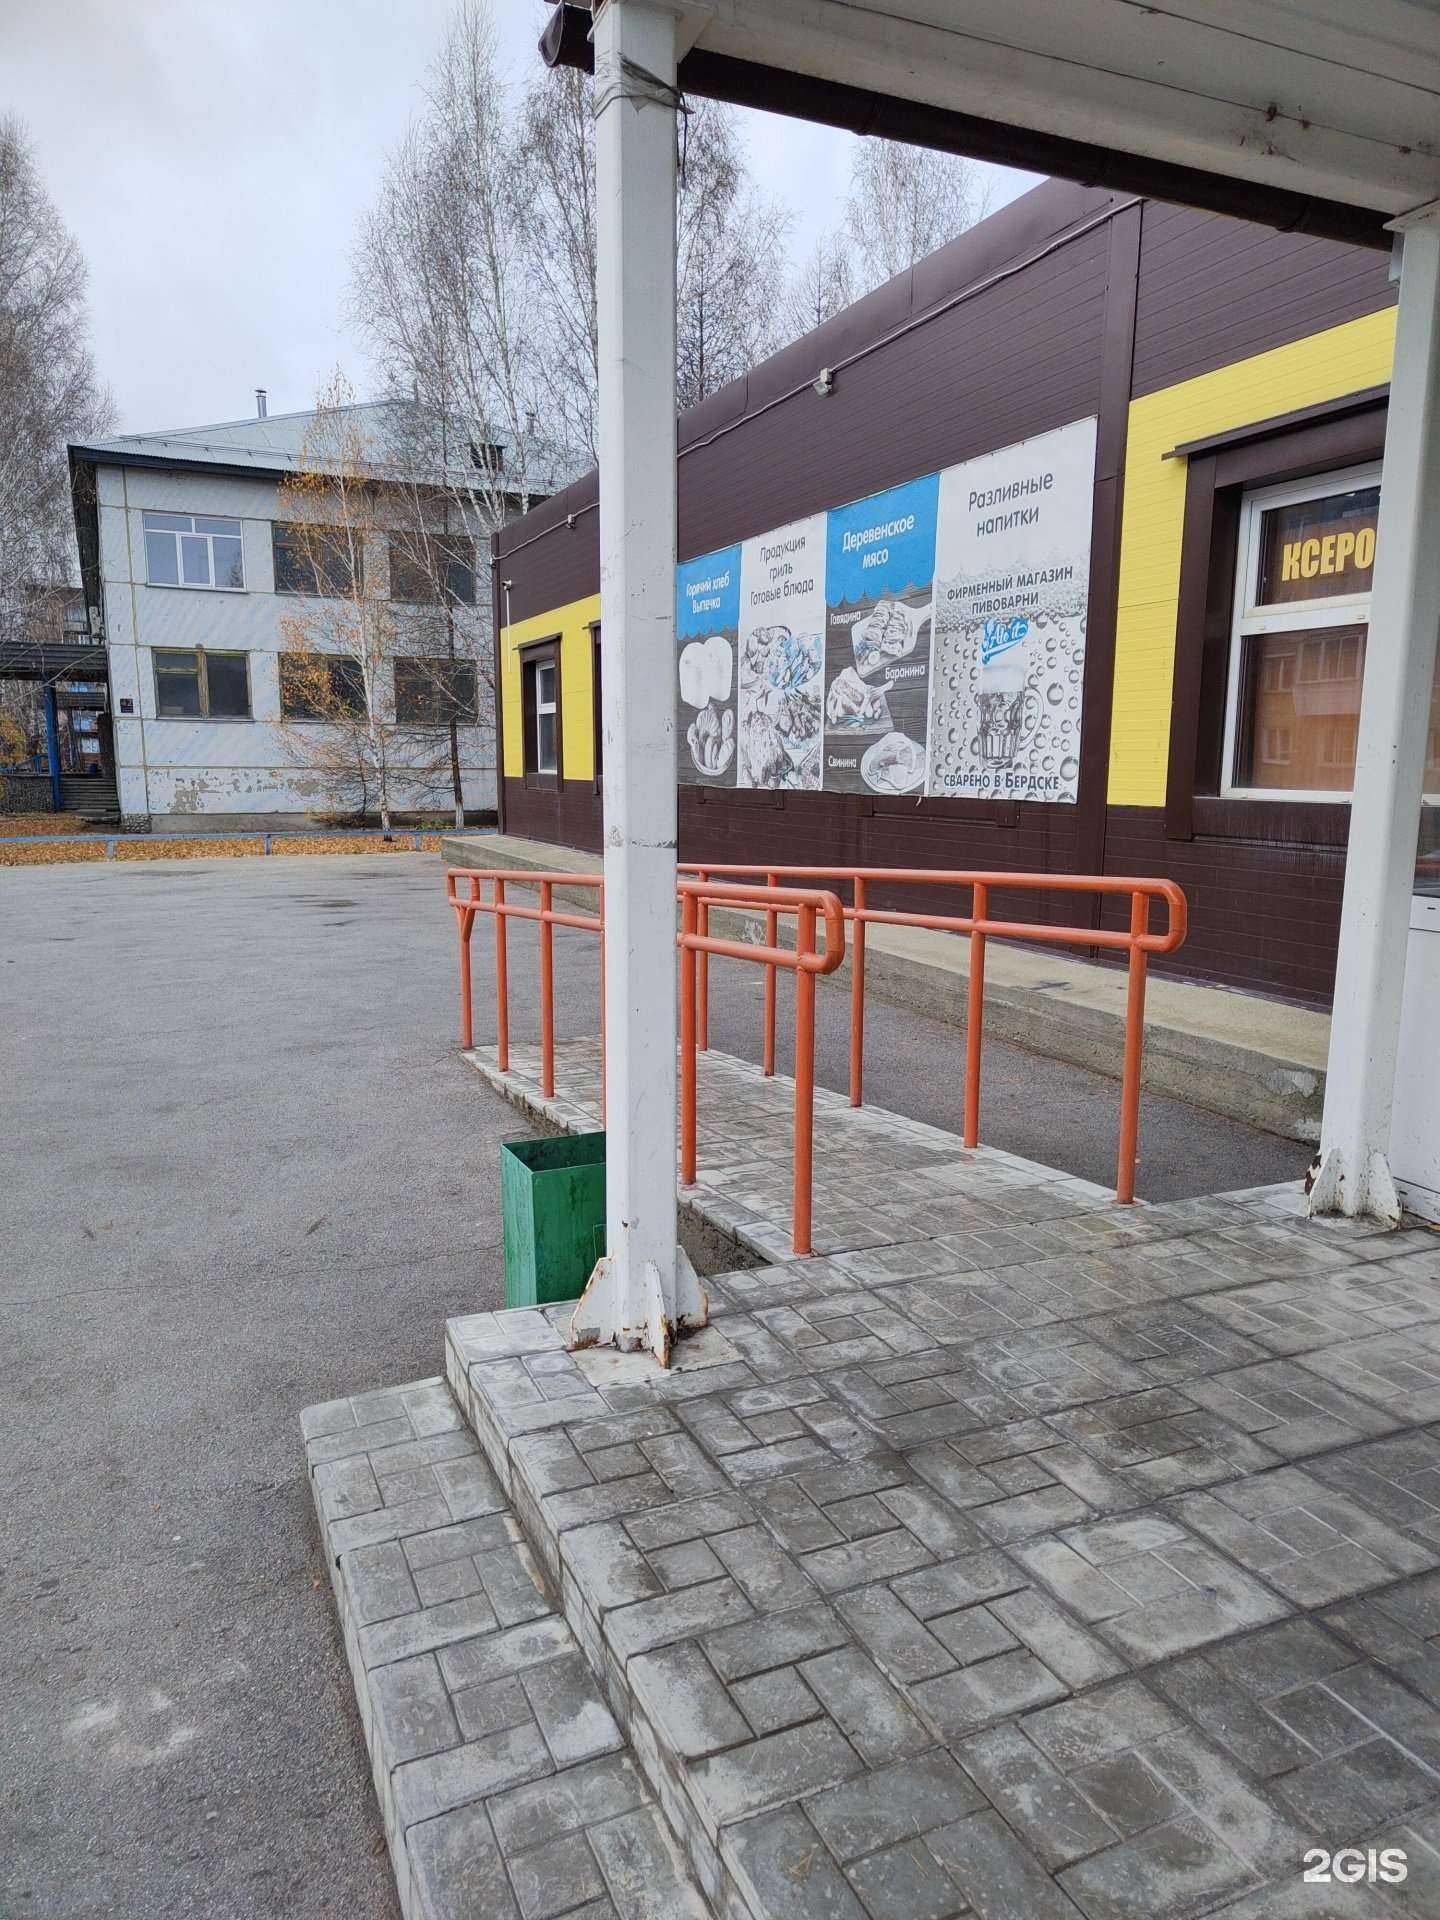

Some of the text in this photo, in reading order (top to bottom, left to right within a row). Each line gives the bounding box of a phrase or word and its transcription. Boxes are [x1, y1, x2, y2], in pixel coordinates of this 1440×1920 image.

[968, 472, 1053, 512] Разливные
[843, 514, 914, 552] Деревенское
[976, 506, 1039, 537] напитки
[760, 536, 806, 565] Продукция
[863, 548, 889, 568] мясо
[1281, 527, 1376, 581] КСЕРО
[712, 569, 730, 591] хлеб
[769, 562, 793, 583] гриль
[947, 566, 1073, 601] ФИРМЕННЫЙ МАГАЗИН
[750, 578, 814, 607] Готовые блюда
[972, 592, 1039, 615] ПИВОВАРНИ
[830, 610, 861, 626] Говядина
[885, 664, 926, 682] Баранина
[828, 755, 857, 769] Свинина
[944, 774, 990, 788] СВАРЕНО
[994, 774, 1001, 788] В
